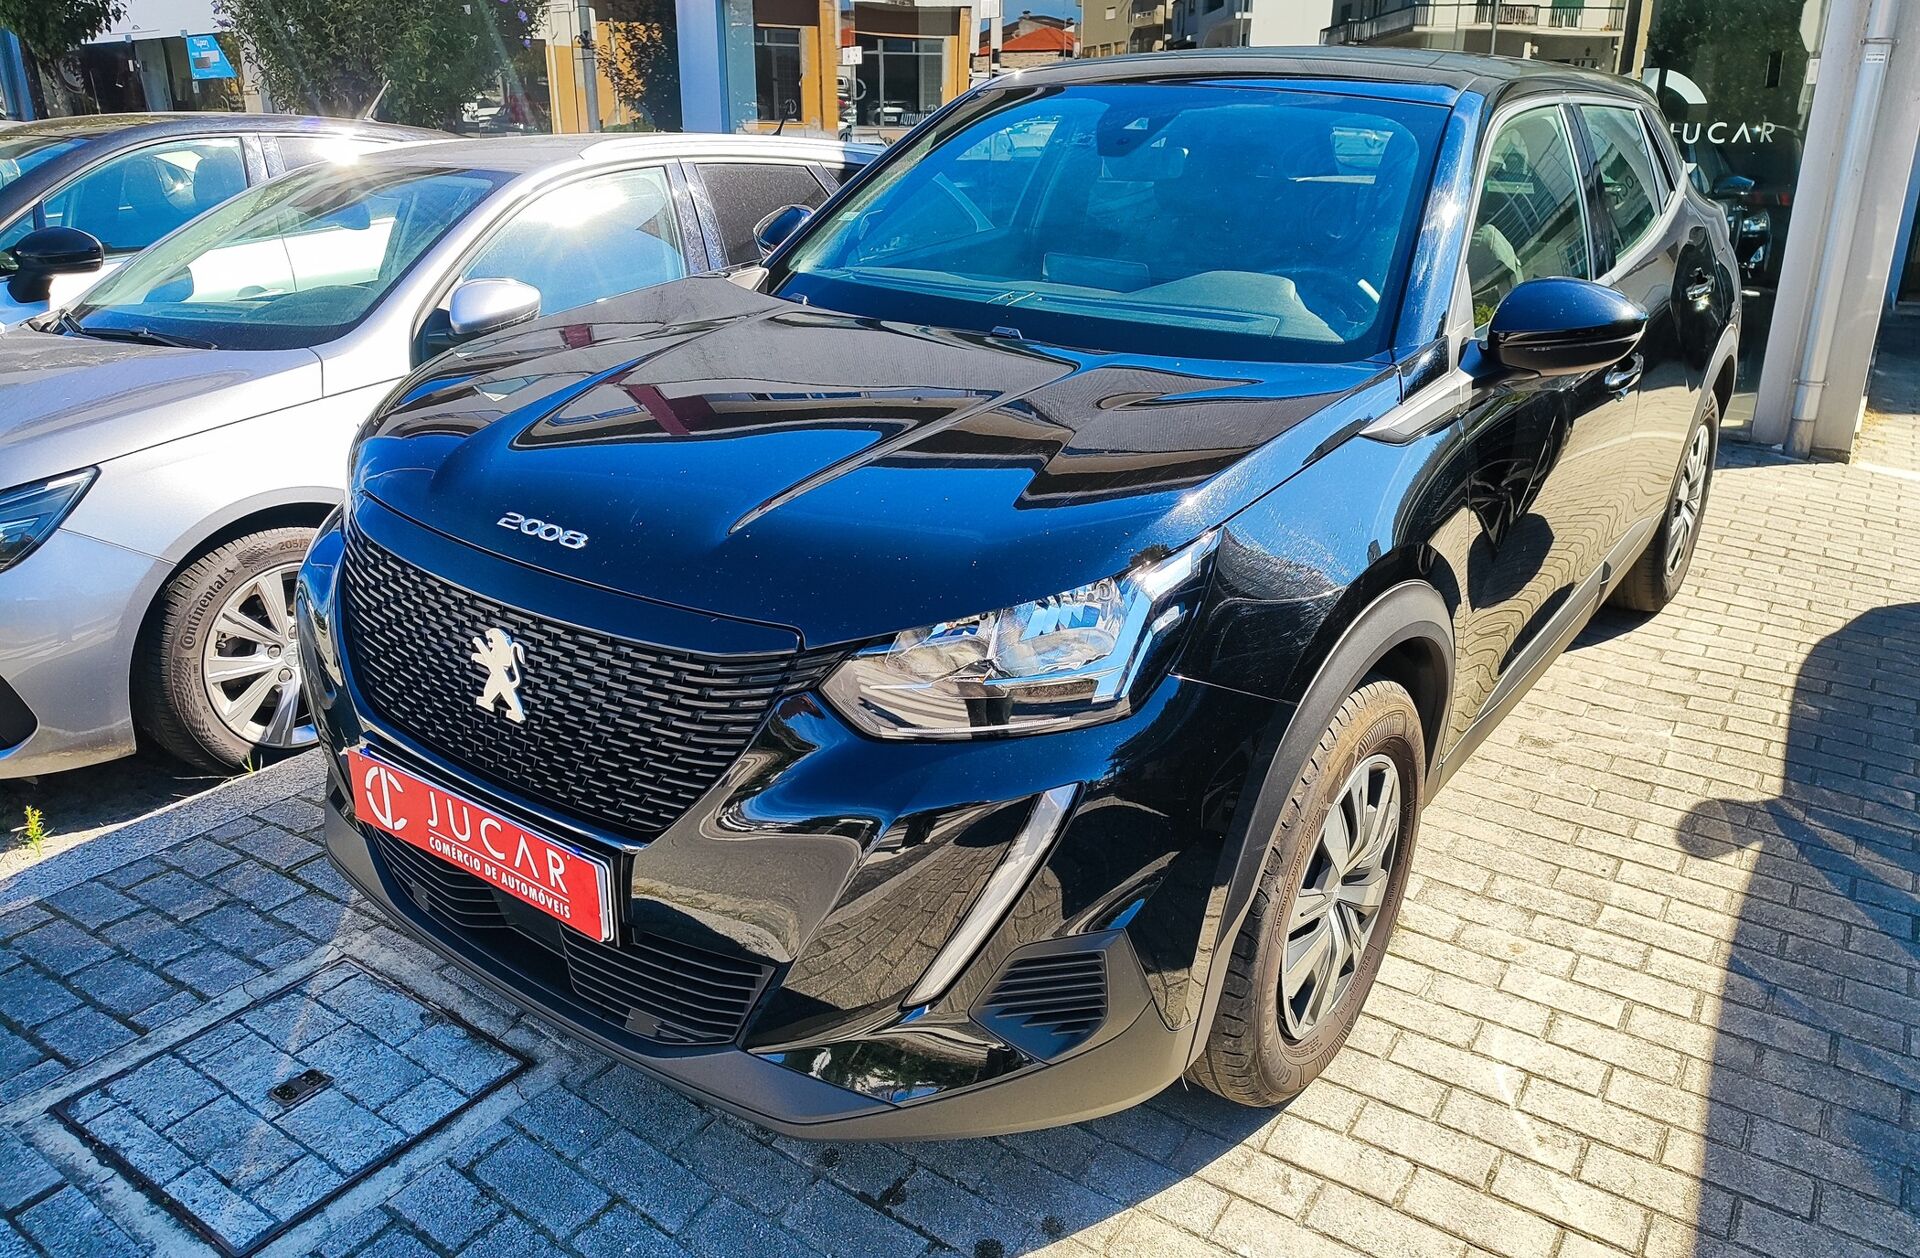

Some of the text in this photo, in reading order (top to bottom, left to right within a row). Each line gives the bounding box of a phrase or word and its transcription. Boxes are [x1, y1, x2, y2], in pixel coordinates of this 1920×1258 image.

[497, 511, 588, 549] 2008
[181, 572, 231, 650] Continental
[427, 790, 569, 894] JUCAR
[429, 836, 571, 919] COMÉRCIO DE AUTOMÓVEIS
